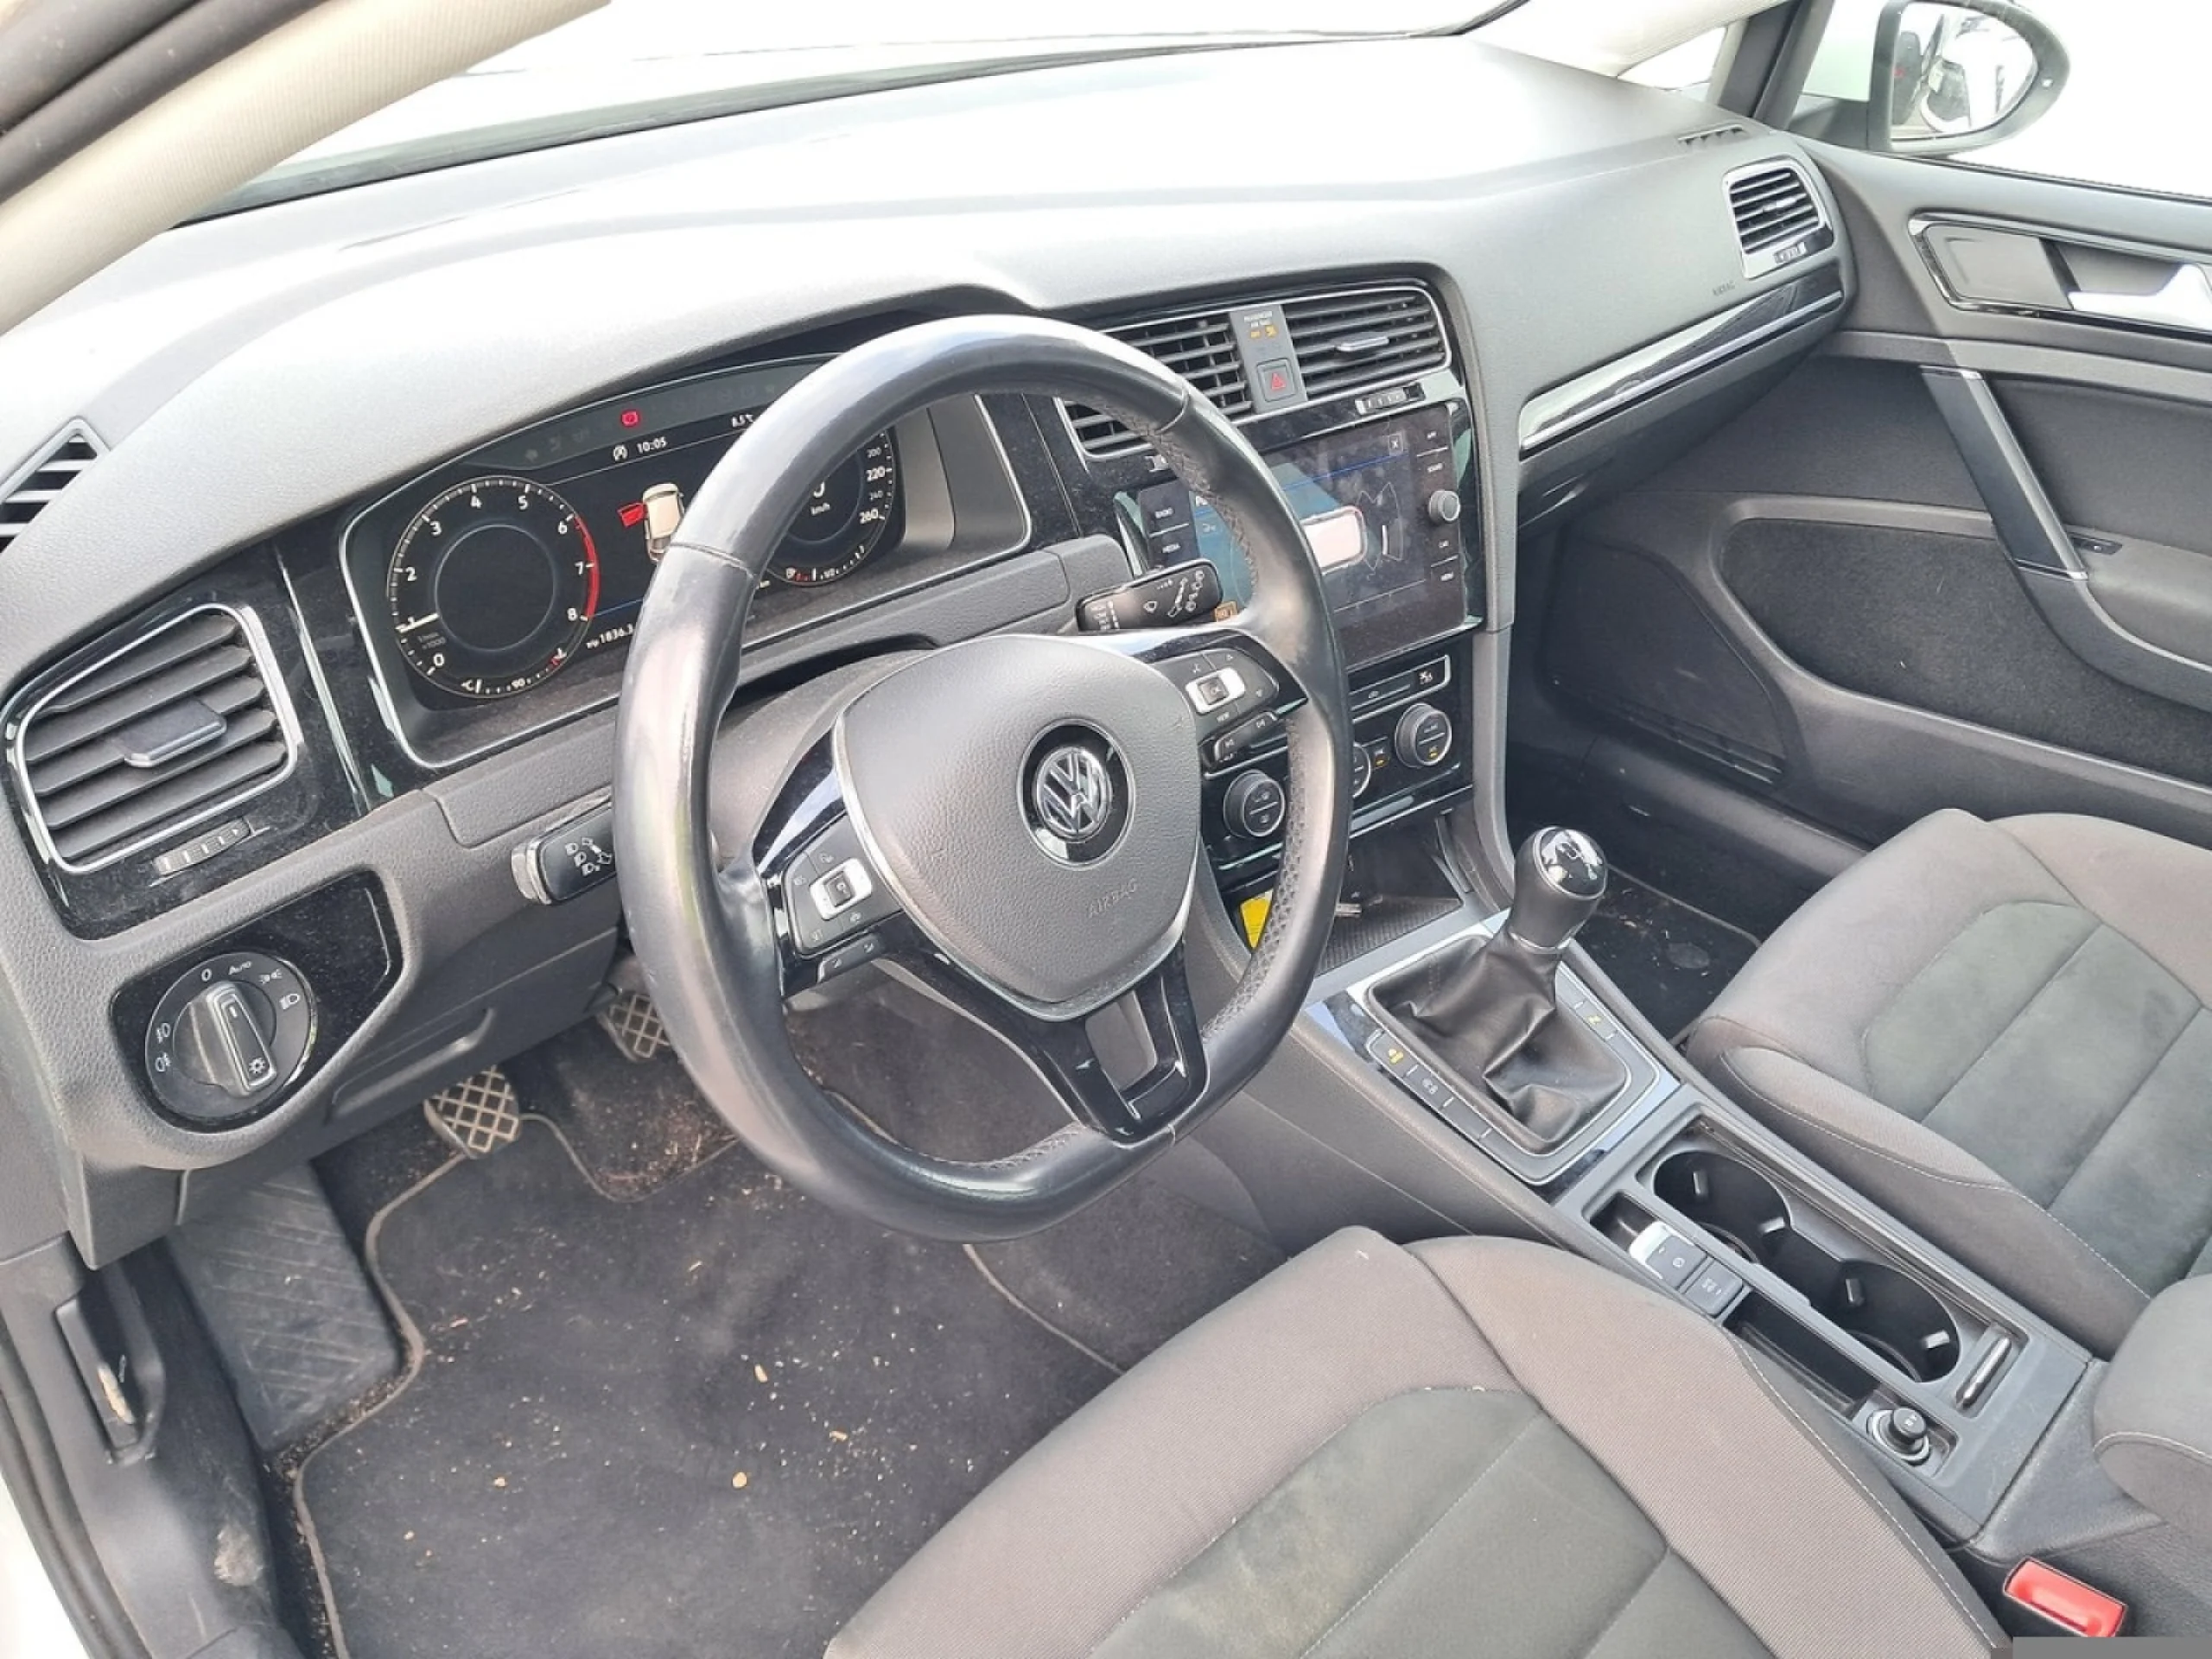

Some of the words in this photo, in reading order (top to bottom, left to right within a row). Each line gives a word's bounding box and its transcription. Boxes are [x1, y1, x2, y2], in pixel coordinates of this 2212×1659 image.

[637, 436, 667, 454] 10:05
[866, 466, 886, 481] 220
[471, 496, 482, 508] 4
[518, 495, 528, 510] 5
[430, 520, 442, 535] 3
[558, 521, 568, 534] 6
[405, 567, 416, 581] 2
[575, 562, 583, 575] 7
[567, 608, 577, 620] 8
[433, 653, 445, 666] 0
[201, 969, 212, 982] 0
